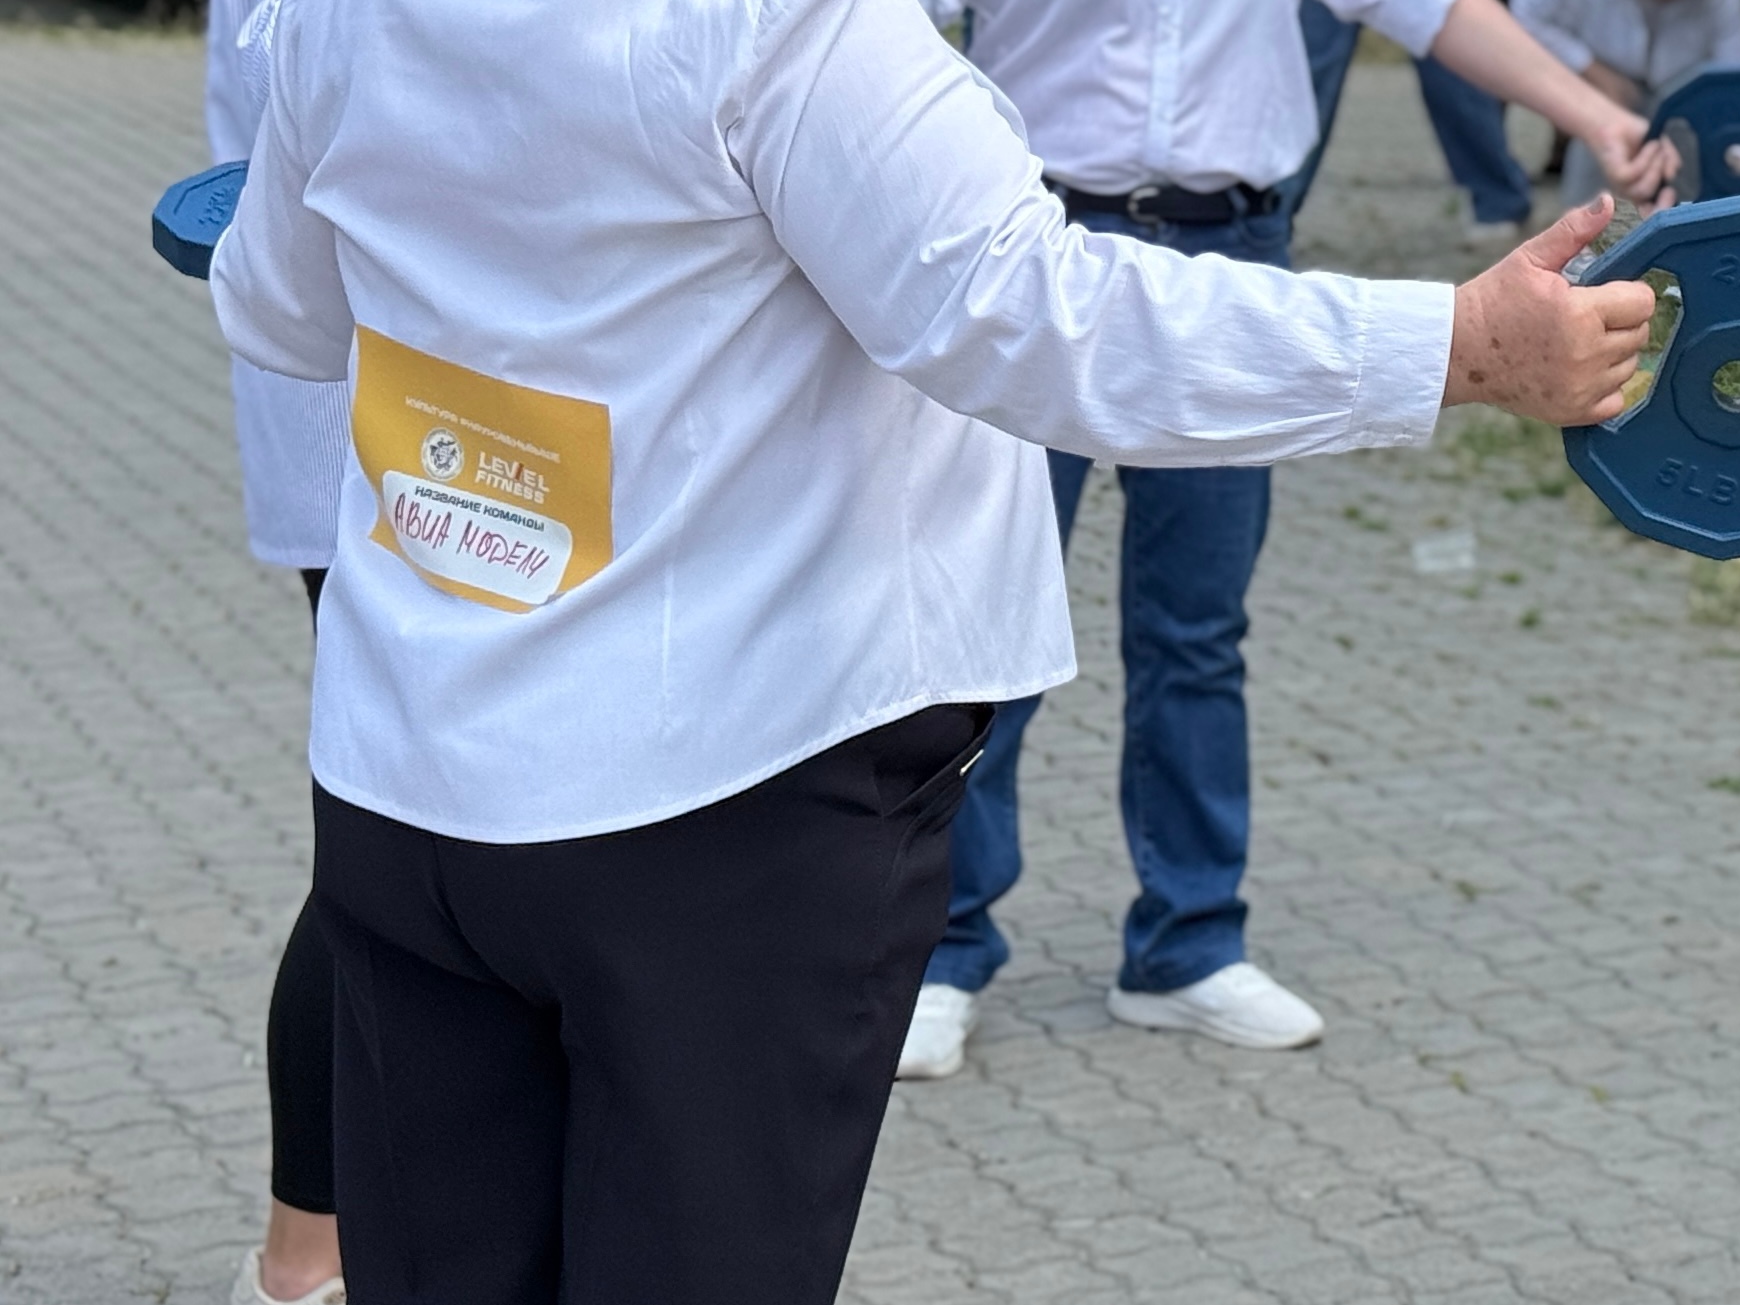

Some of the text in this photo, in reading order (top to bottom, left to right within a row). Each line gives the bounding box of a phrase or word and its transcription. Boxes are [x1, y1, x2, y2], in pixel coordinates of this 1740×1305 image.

[474, 470, 545, 505] FITNESS
[478, 451, 551, 493] LEVEL
[1656, 457, 1740, 505] 5LB
[415, 486, 545, 532] НАЗВАНИЕ КОМАНДЫ
